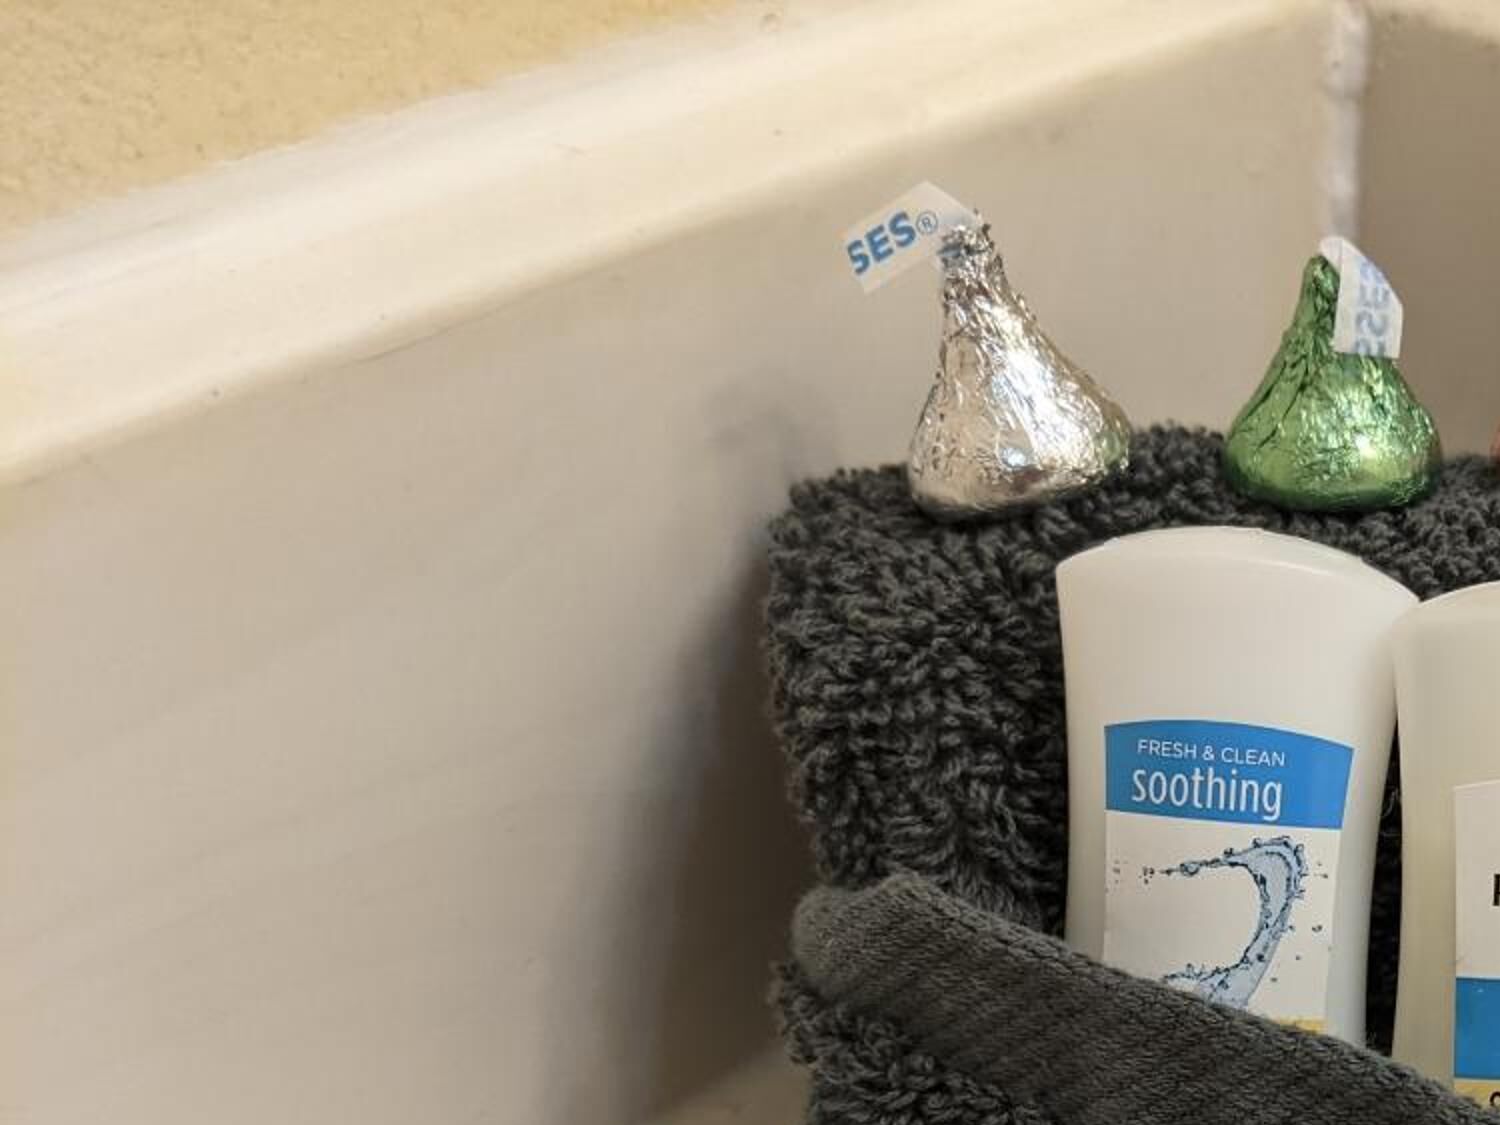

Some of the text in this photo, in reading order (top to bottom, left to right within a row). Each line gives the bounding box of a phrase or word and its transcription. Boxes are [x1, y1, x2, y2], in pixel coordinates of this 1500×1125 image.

[1137, 739, 1286, 767] FRESH & CLEAN
[1131, 768, 1283, 821] soothing
